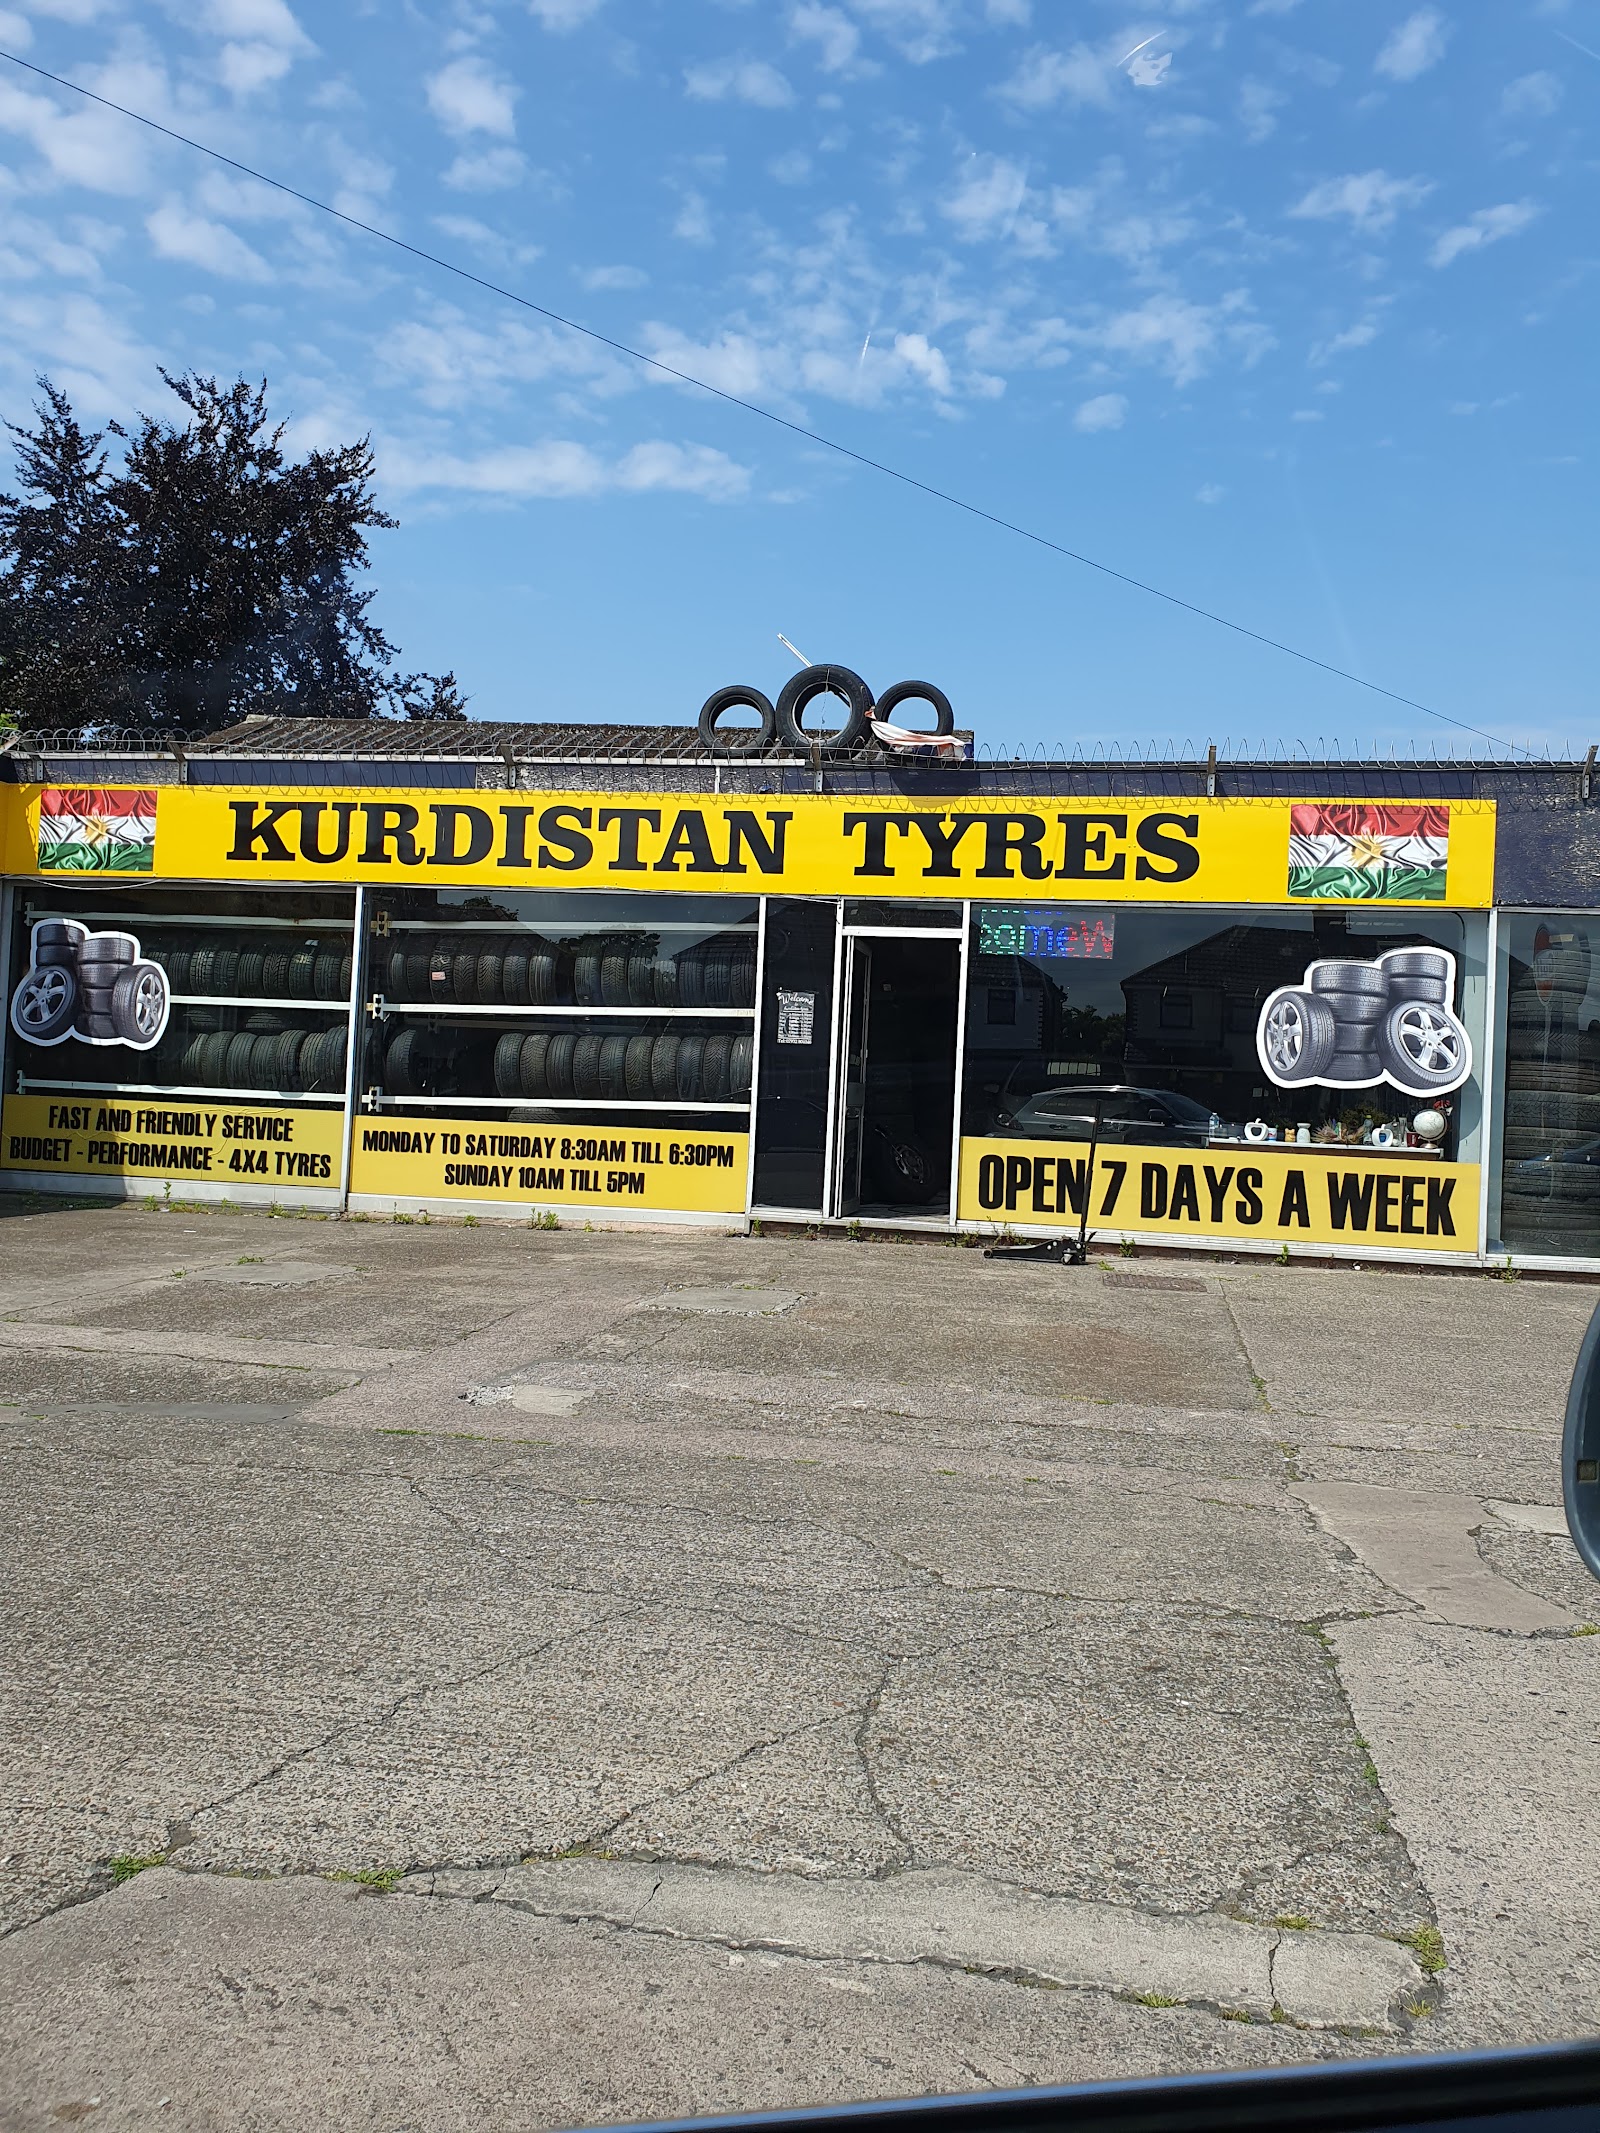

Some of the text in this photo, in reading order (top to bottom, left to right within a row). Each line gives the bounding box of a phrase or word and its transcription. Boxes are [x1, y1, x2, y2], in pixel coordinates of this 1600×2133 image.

[226, 801, 1200, 882] KURDISTAN TYRES
[48, 1105, 294, 1142] FAST AND FRIENDLY SERVICE
[10, 1136, 72, 1162] BUDGET
[87, 1140, 213, 1171] PERFORMANCE
[229, 1149, 268, 1174] 4X4
[275, 1152, 331, 1178] TYRES
[362, 1130, 734, 1167] MONDAY TO SATURDAY 8:30AM TILL 6:30PM
[444, 1163, 645, 1194] SUNDAY 10AM TILL 5PM
[978, 1154, 1457, 1236] OPEN 7 DAYS A WEEK
